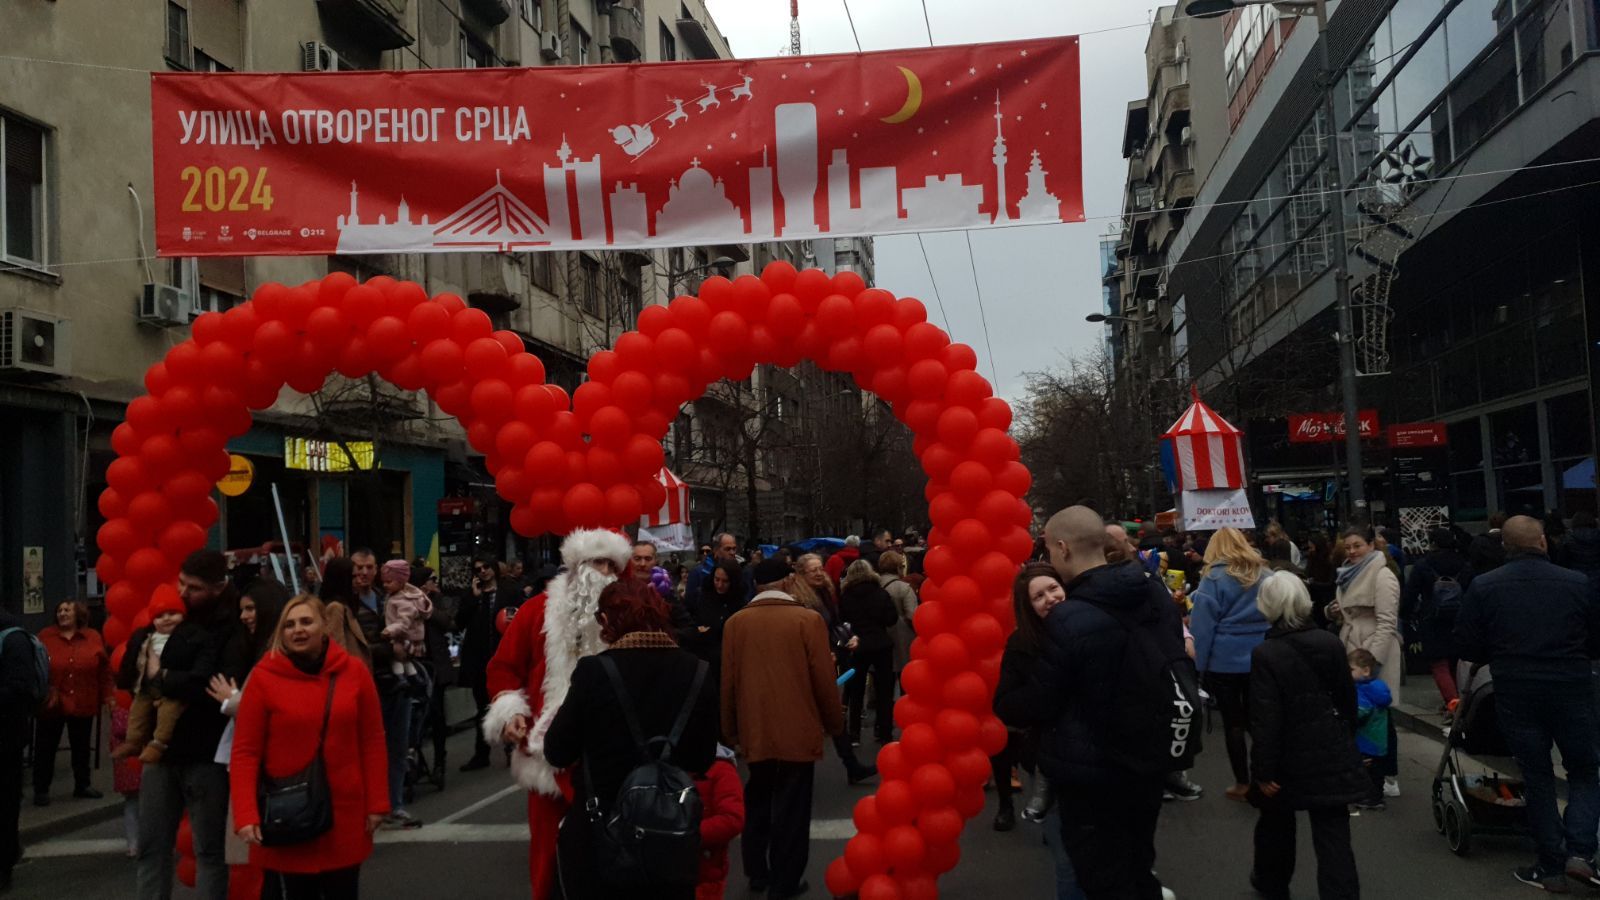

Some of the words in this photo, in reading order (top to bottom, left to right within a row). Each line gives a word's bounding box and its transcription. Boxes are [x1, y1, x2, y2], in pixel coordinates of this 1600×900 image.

[178, 110, 277, 150] УЛИЦА
[281, 107, 445, 144] ОТВОРЕНОГ
[455, 106, 531, 145] СРЦА
[181, 166, 274, 212] 2024
[1296, 418, 1322, 438] Moj
[1197, 507, 1230, 516] DOKTORI
